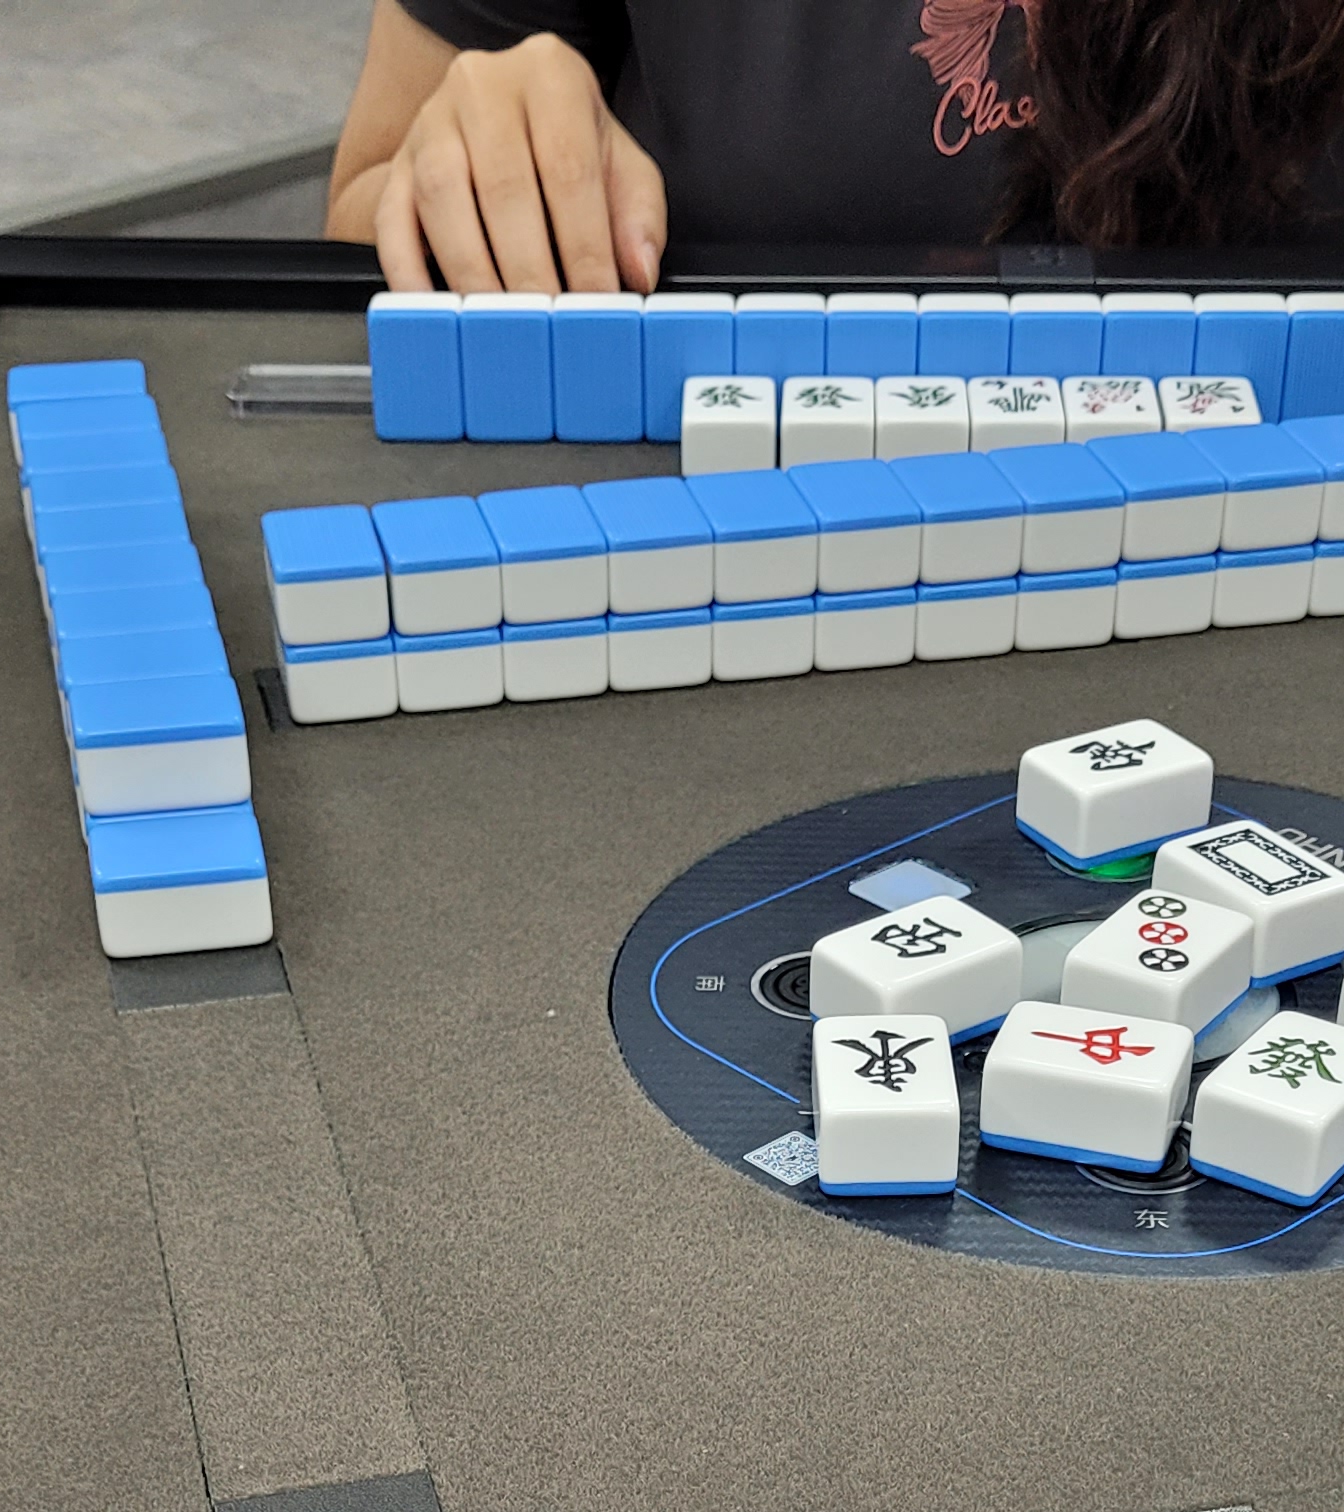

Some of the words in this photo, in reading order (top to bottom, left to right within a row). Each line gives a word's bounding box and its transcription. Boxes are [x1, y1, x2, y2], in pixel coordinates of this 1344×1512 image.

[870, 916, 963, 958] 西
[695, 975, 726, 993] 南
[830, 1029, 935, 1093] 東
[1030, 1026, 1156, 1065] 中
[1133, 1208, 1170, 1229] 东
